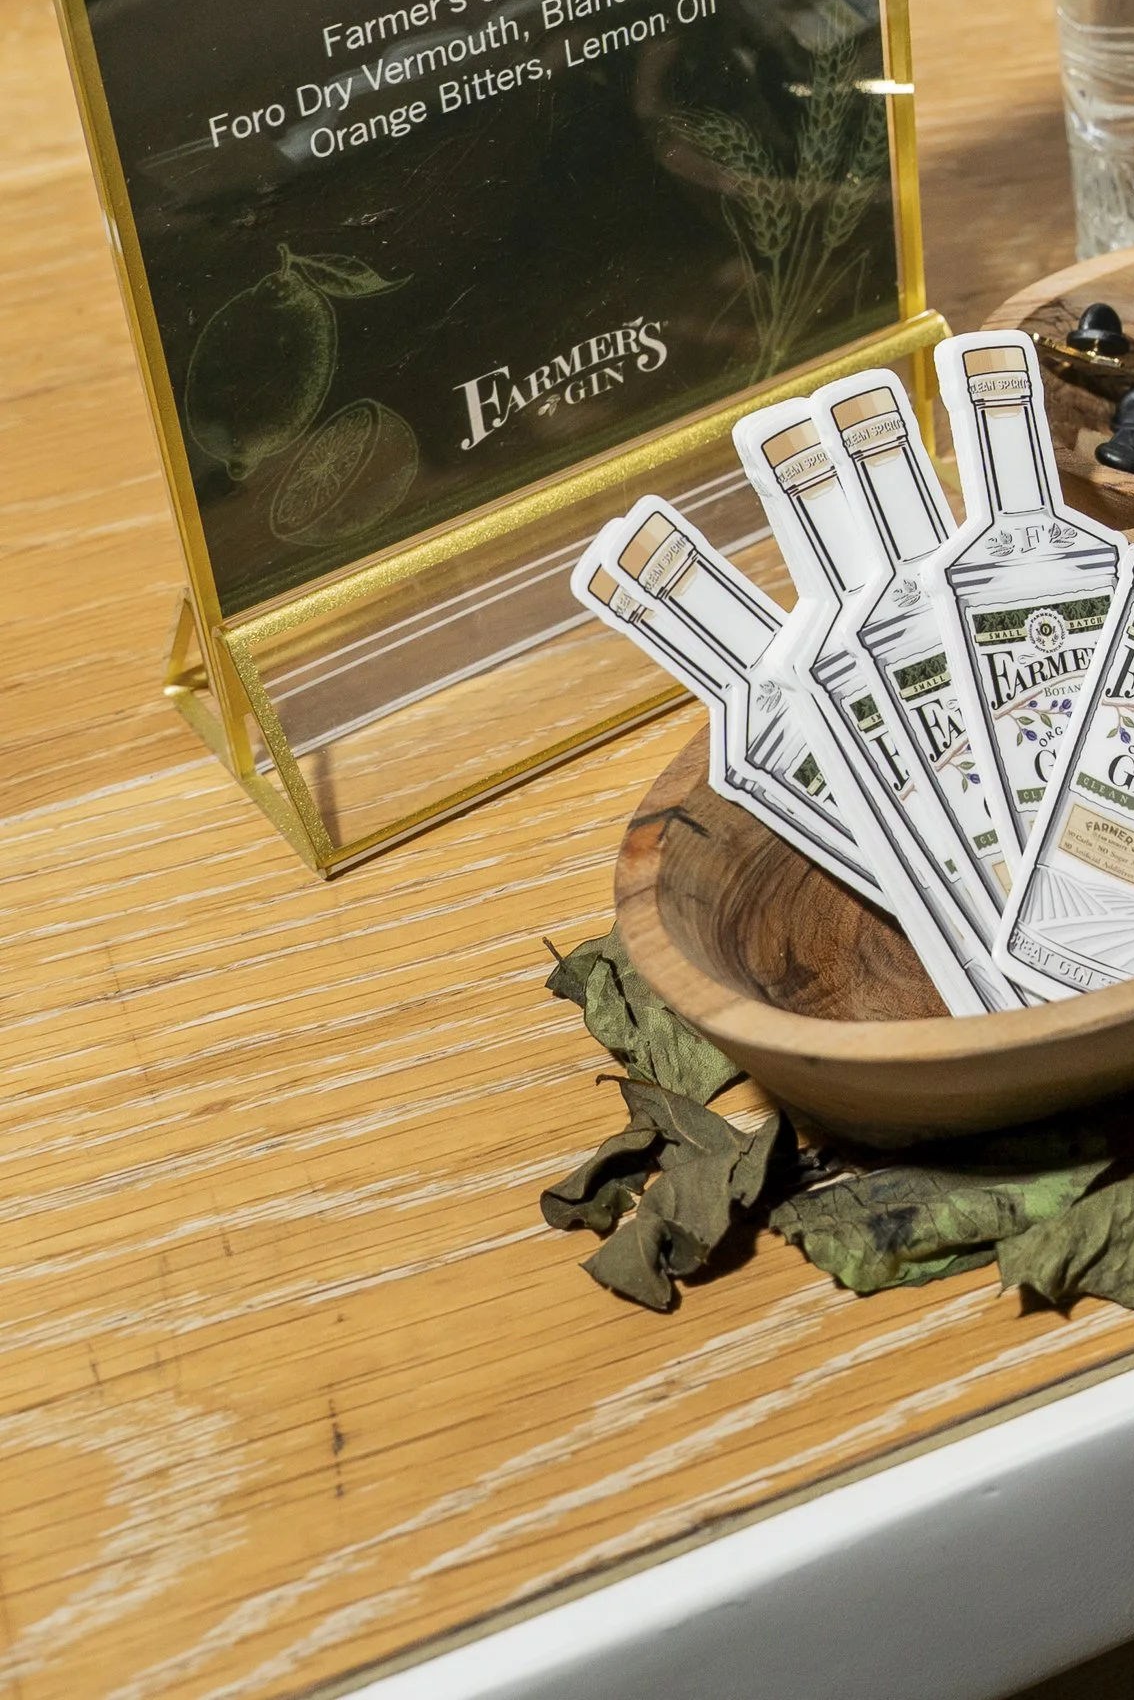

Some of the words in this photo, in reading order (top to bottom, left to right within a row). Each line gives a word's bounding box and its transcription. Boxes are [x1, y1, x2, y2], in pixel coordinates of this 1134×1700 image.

[208, 104, 286, 148] Foro
[297, 76, 353, 117] Dry
[361, 15, 531, 93] Vermouth,
[310, 99, 427, 159] Orange
[438, 56, 553, 114] Bitters,
[563, 16, 668, 68] Lemon
[564, 362, 624, 405] GIN
[988, 629, 1022, 640] SMALL
[1069, 617, 1103, 628] BATCH
[913, 675, 946, 693] SMALL
[981, 647, 1096, 711] FARME
[1083, 776, 1129, 804] CLEAN
[1059, 960, 1094, 986] GIN
